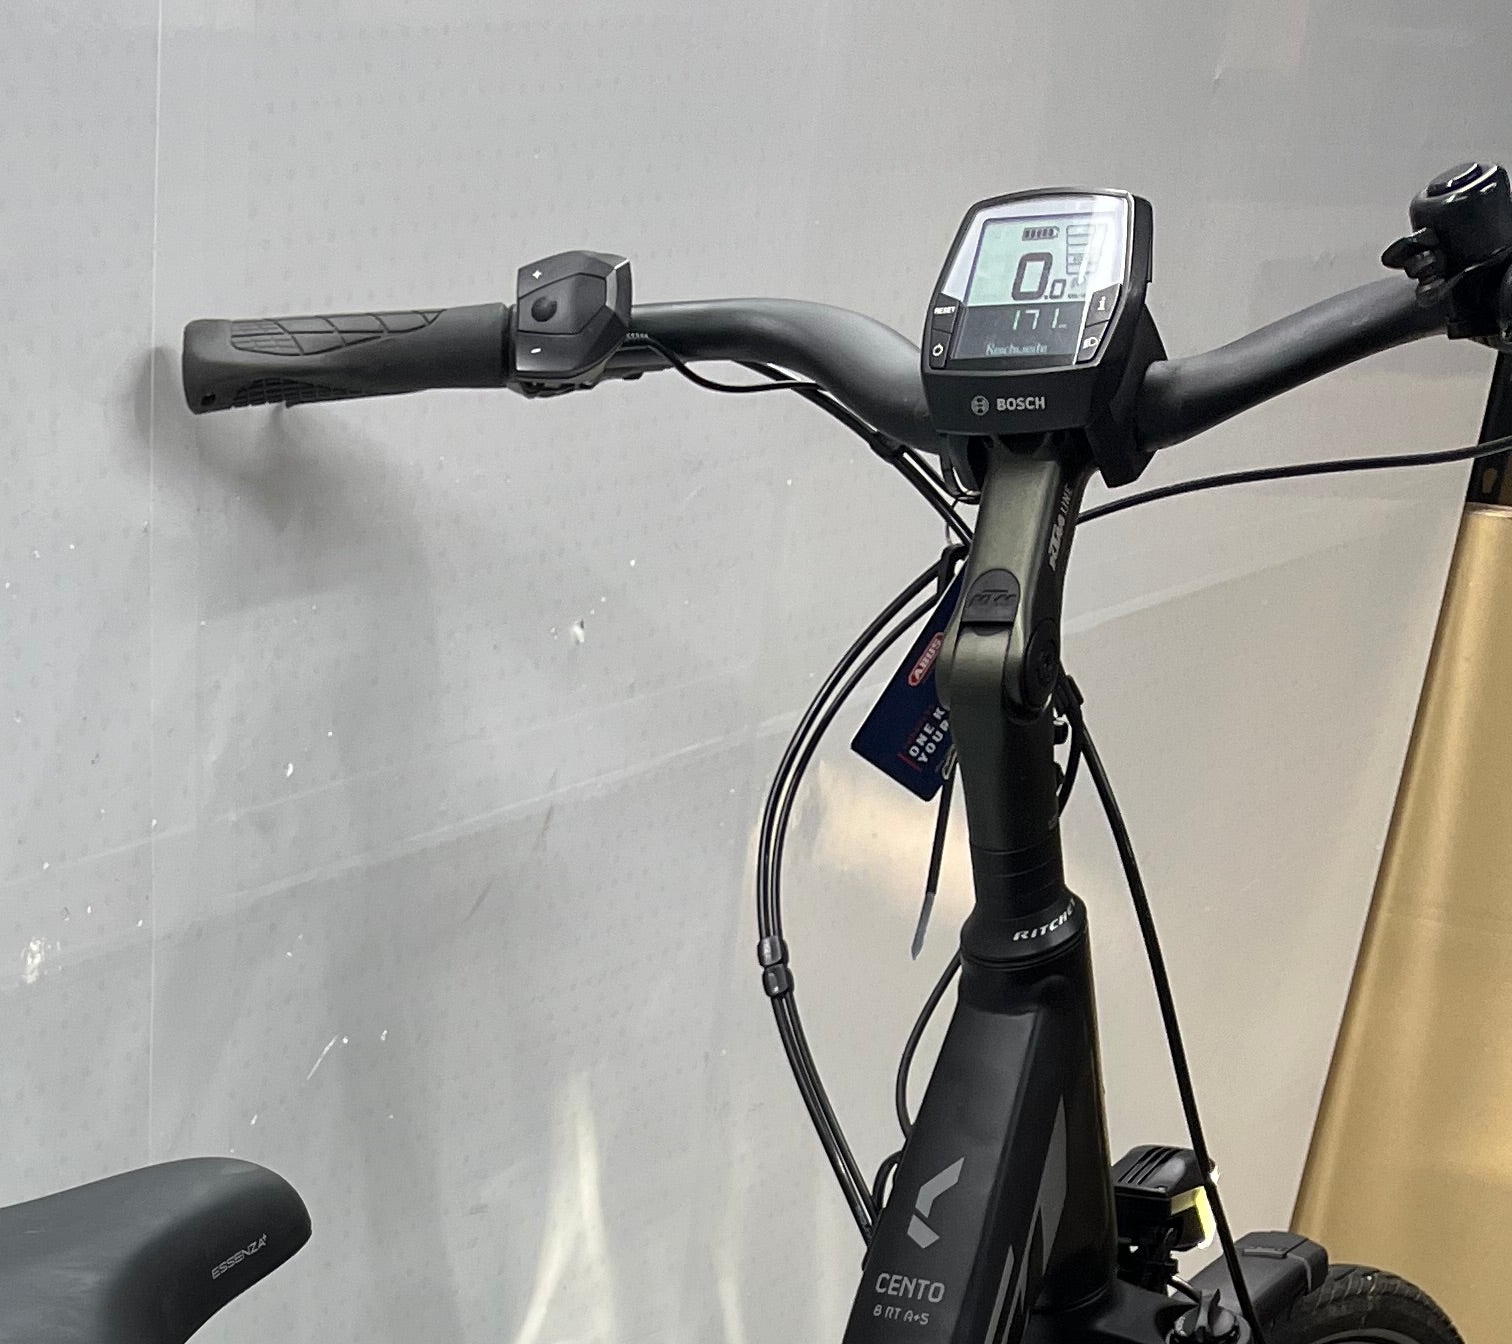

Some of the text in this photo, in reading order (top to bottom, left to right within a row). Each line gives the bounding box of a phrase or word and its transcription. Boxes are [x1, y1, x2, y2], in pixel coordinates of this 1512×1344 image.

[933, 305, 956, 315] RESET
[996, 396, 1046, 412] BOSCH
[914, 638, 943, 679] ABUS
[908, 723, 935, 757] ONE
[875, 1272, 945, 1303] CENTO
